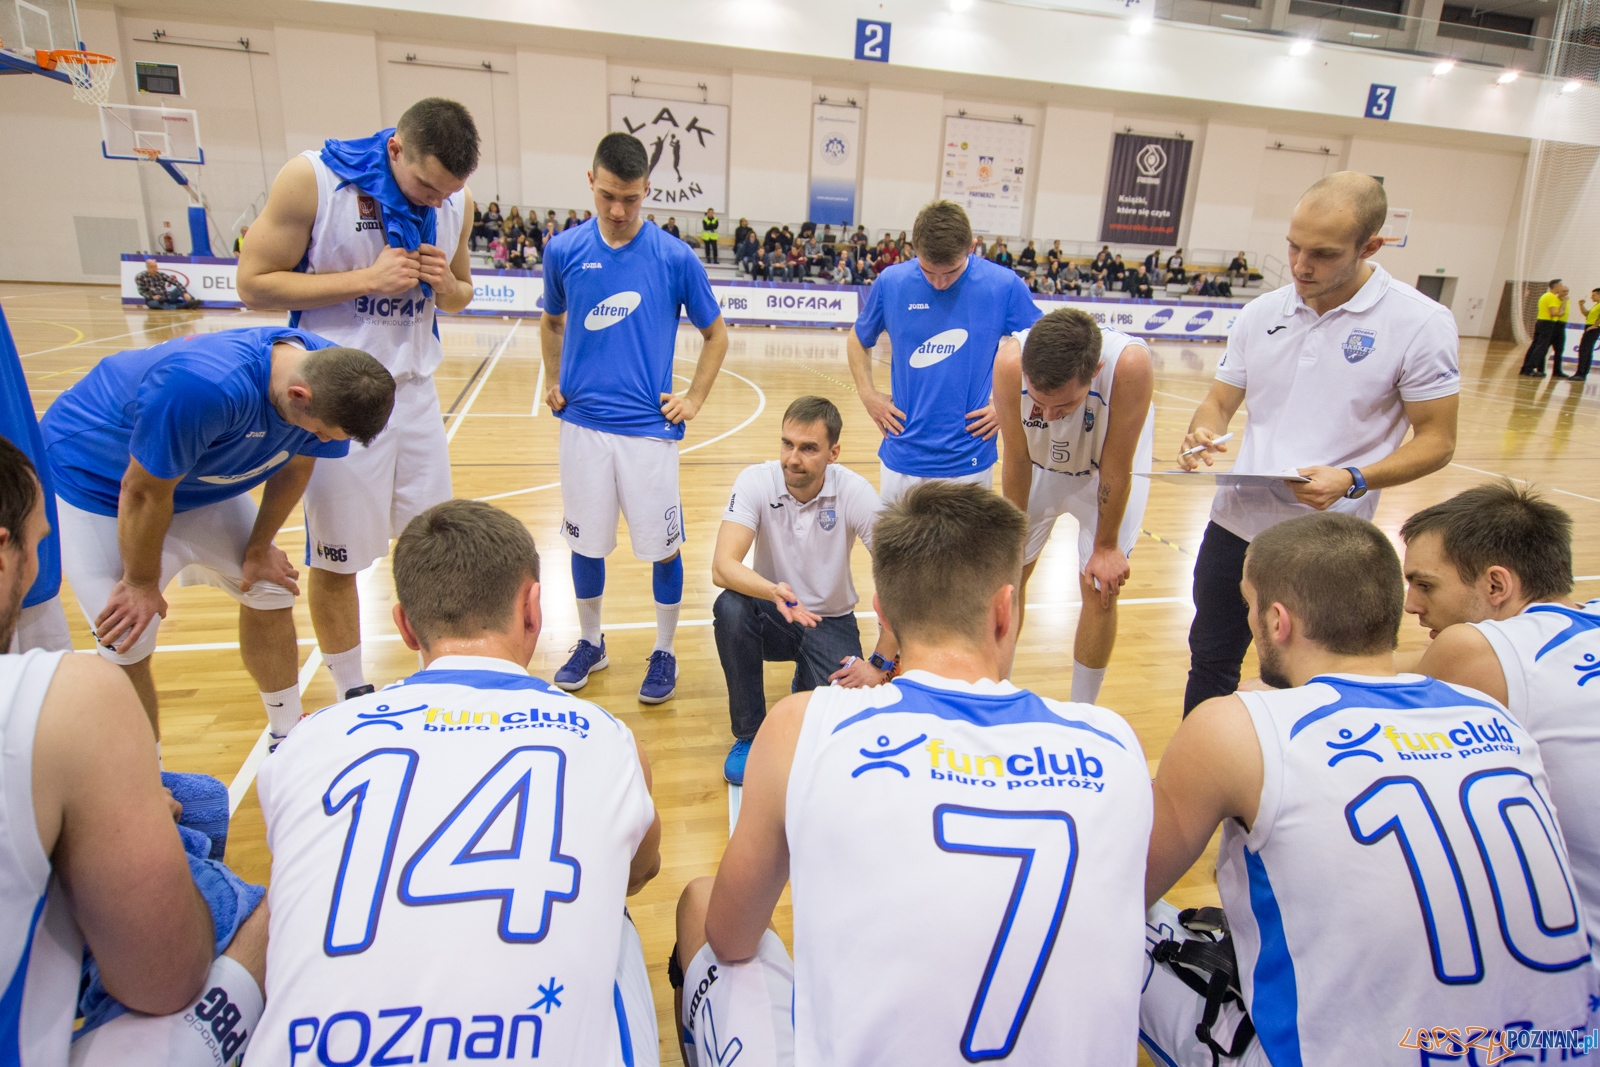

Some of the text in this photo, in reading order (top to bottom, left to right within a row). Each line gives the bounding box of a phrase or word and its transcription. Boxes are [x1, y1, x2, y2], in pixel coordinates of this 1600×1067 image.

[863, 24, 884, 58] 2
[1371, 88, 1390, 116] 3
[623, 107, 715, 148] LAK
[1150, 210, 1171, 218] czyta
[592, 304, 629, 317] atrem
[728, 297, 748, 310] PBG
[766, 295, 842, 310] BIOFARM
[1117, 314, 1133, 325] PBG
[918, 342, 955, 354] atrem
[665, 422, 670, 430] 2
[972, 457, 978, 466] 3
[664, 505, 679, 536] 2
[323, 545, 348, 562] PBG
[424, 723, 490, 732] biuro
[1397, 751, 1452, 760] biuro
[931, 769, 1105, 793] biuro podróży
[322, 745, 581, 957] 14
[1345, 767, 1592, 985] 10
[932, 803, 1079, 1063] 7
[195, 987, 247, 1064] PBG
